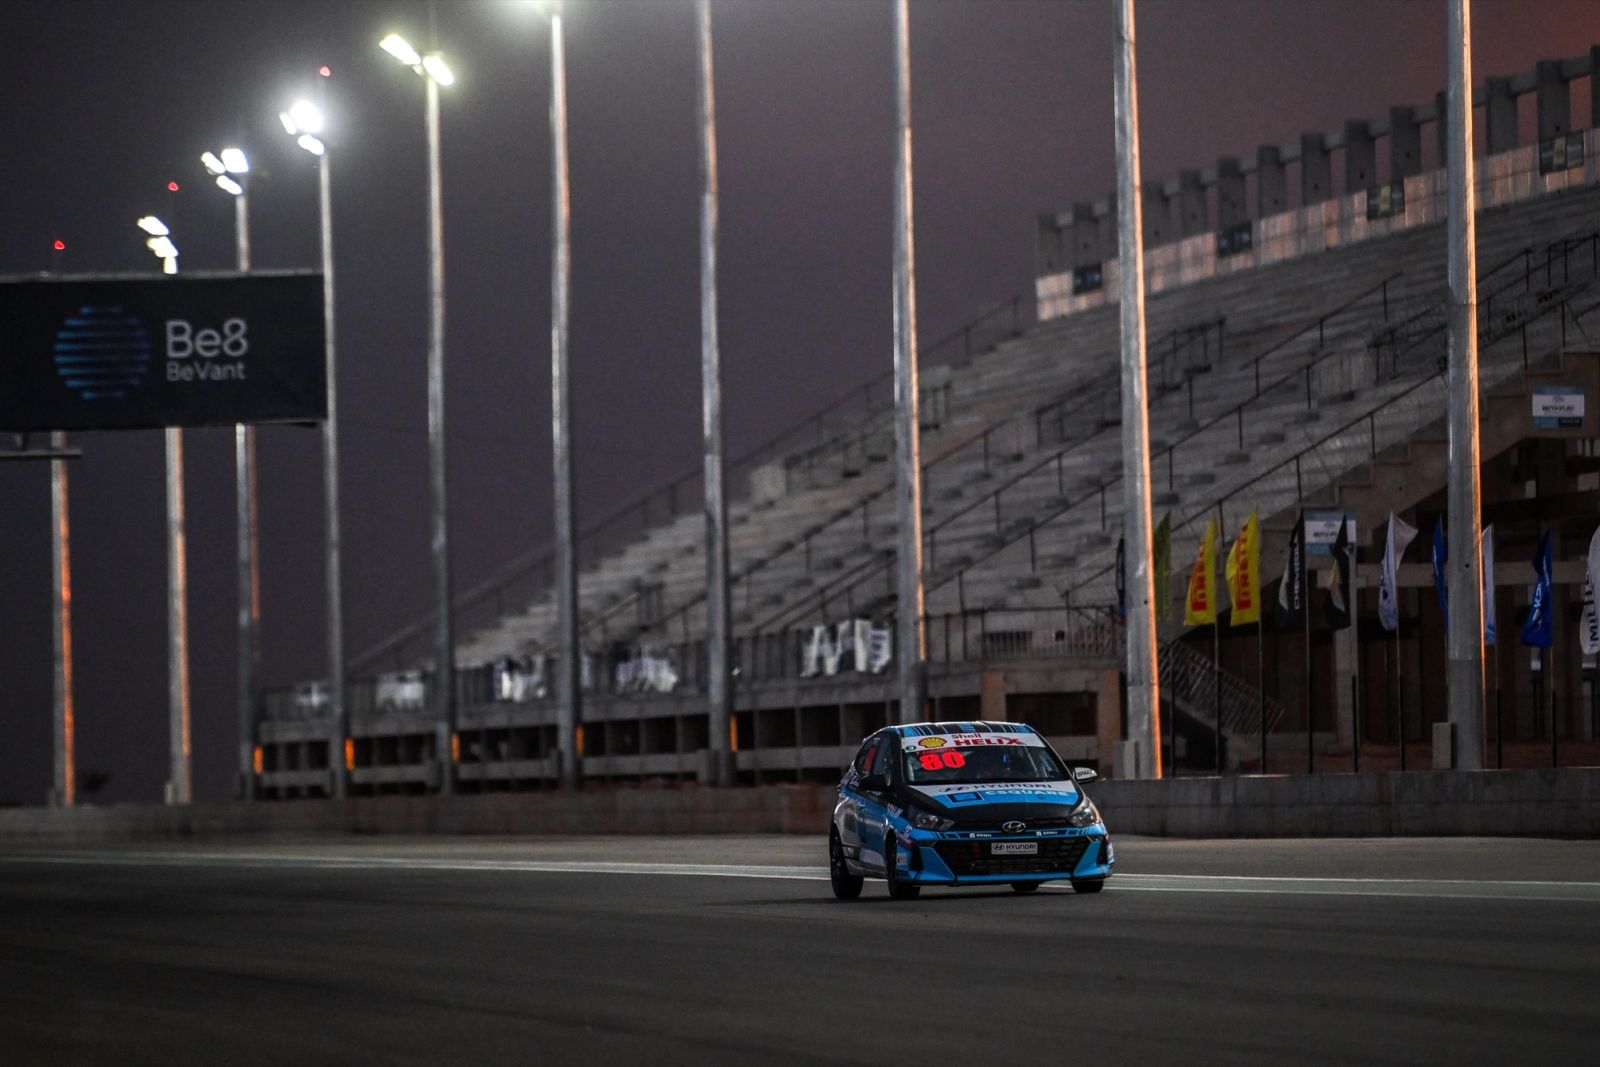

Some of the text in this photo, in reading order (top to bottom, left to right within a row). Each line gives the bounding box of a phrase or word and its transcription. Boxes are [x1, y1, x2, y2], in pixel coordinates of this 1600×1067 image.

[166, 318, 249, 359] Be8
[166, 361, 245, 382] BeVant
[954, 738, 1022, 746] HELIX
[919, 751, 968, 771] 80
